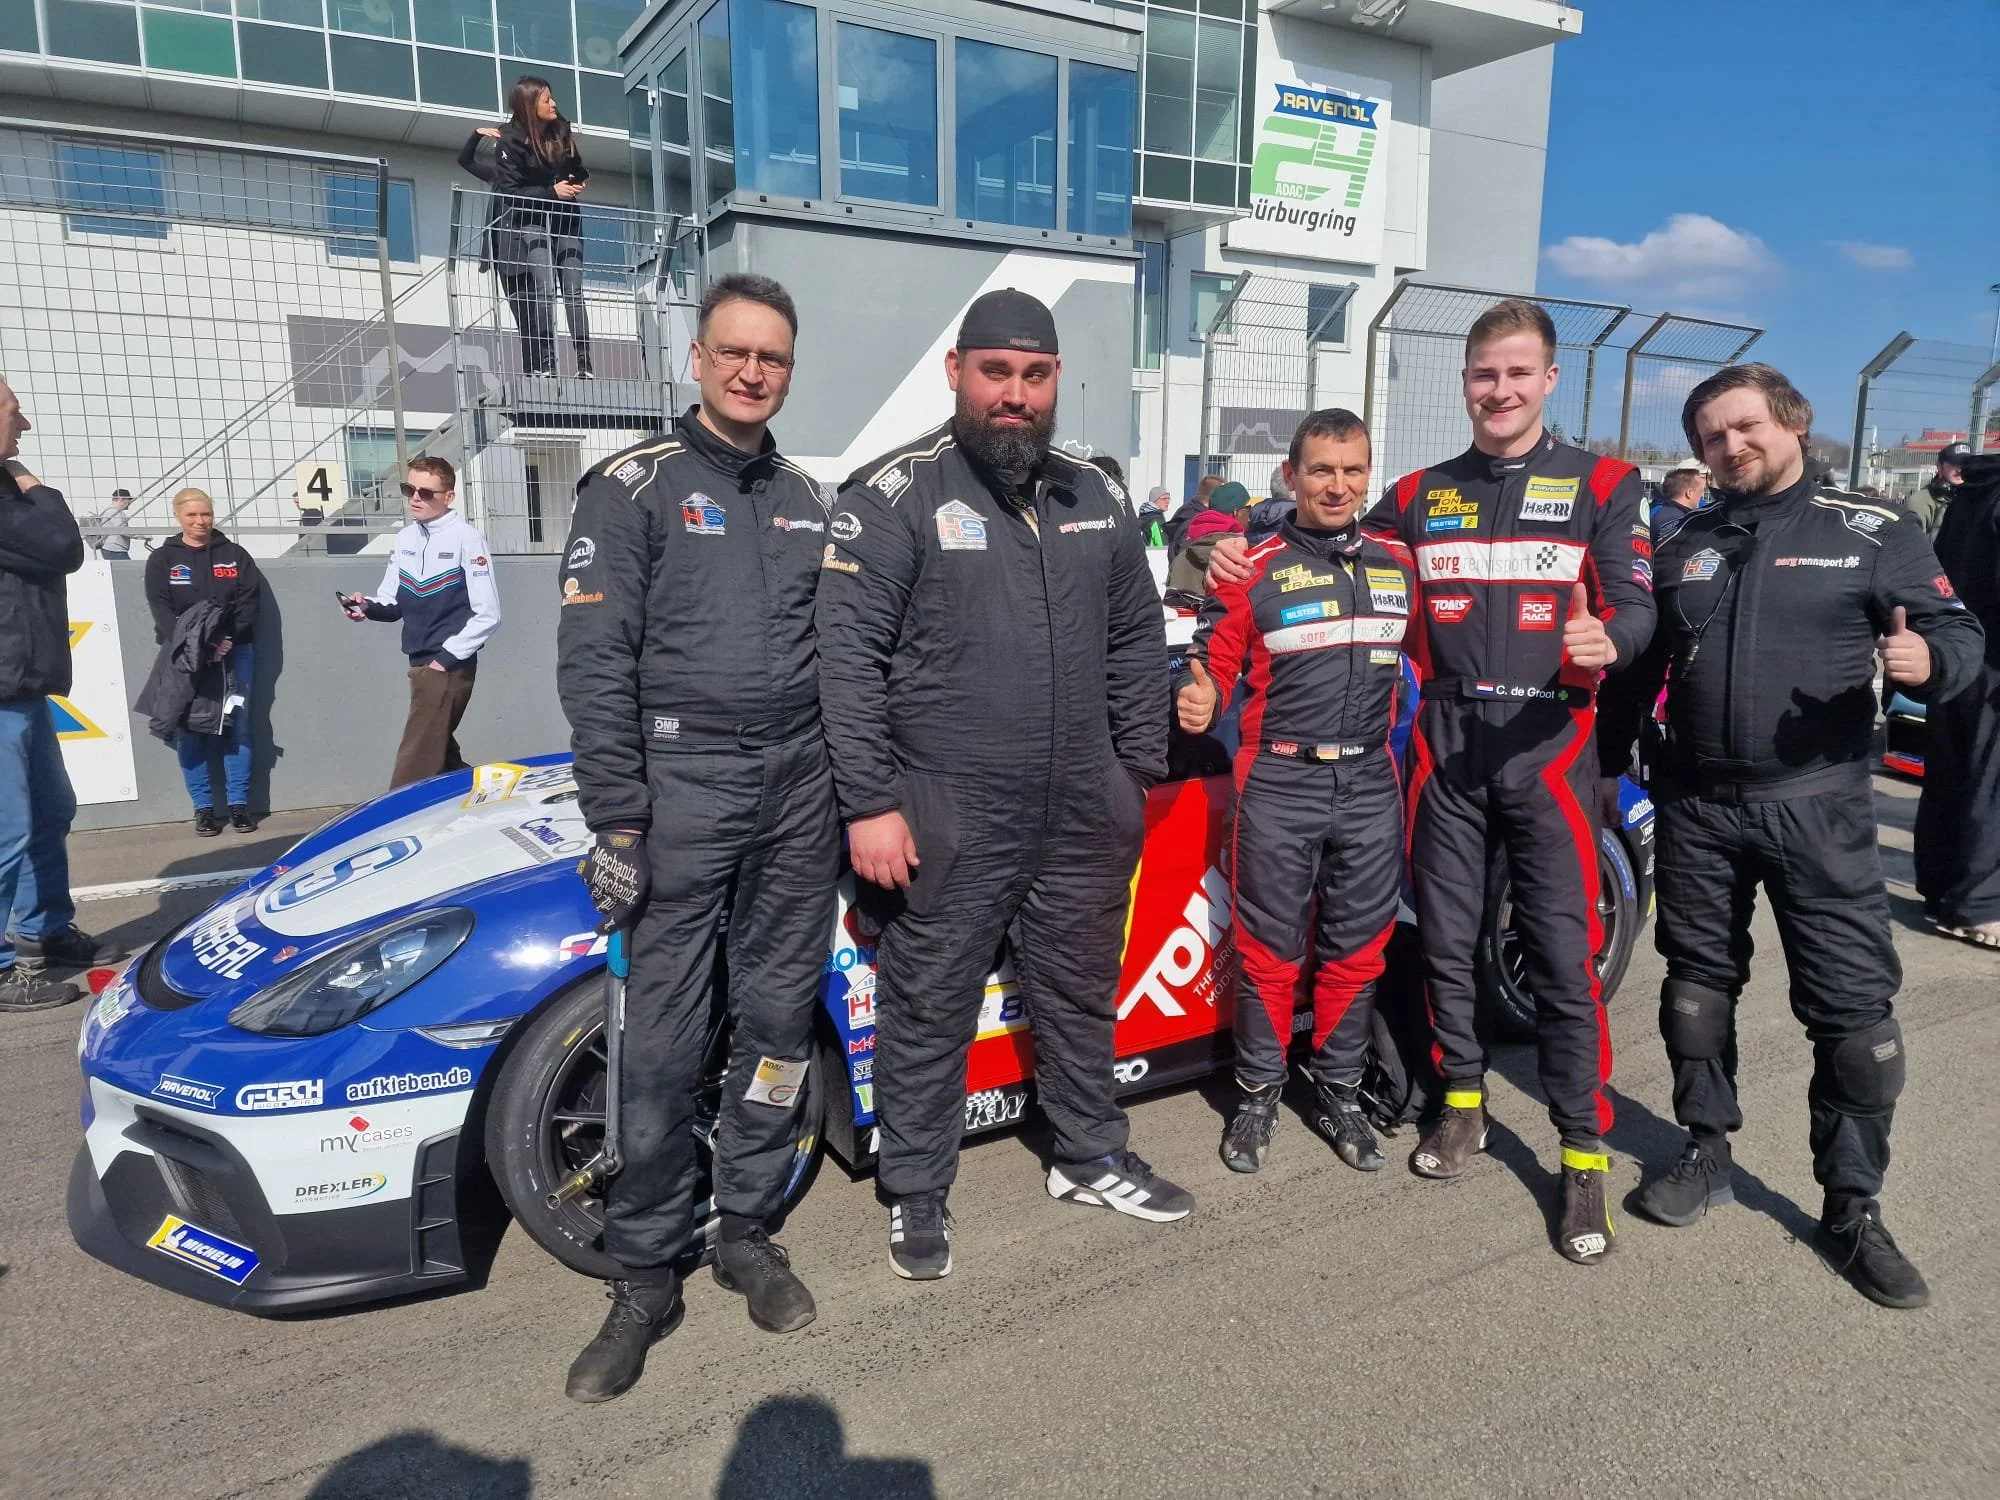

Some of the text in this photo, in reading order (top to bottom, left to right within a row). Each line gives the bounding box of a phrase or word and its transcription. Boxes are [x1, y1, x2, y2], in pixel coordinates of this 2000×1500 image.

[1283, 92, 1370, 123] RAVENOL
[1275, 182, 1304, 199] ADAC
[307, 467, 332, 501] 4
[879, 469, 902, 491] OMP
[1430, 490, 1456, 499] GET
[1441, 498, 1460, 506] ON
[683, 506, 726, 526] HS
[1431, 503, 1476, 515] TRACK
[939, 516, 986, 540] HS
[1853, 512, 1884, 527] OMP
[1274, 564, 1301, 579] GET
[1431, 556, 1460, 574] sorg
[1684, 559, 1720, 574] HS
[1283, 576, 1332, 591] TRACK
[1522, 603, 1553, 613] POP
[1522, 613, 1552, 621] RACE
[1300, 630, 1326, 644] sorg
[1496, 685, 1555, 699] C. de Groot
[654, 719, 680, 731] OMP
[1271, 743, 1298, 755] OMP
[591, 846, 638, 885] Mechanix
[591, 864, 639, 905] Mechanix
[1192, 969, 1216, 997] THE
[849, 993, 877, 1018] H
[999, 996, 1025, 1023] 8
[1113, 1057, 1149, 1084] RO
[160, 1080, 214, 1102] RAVENOL
[347, 1067, 472, 1101] aufkleben.de
[295, 1177, 374, 1197] DREXLER
[1573, 1236, 1607, 1253] OMP
[180, 1238, 246, 1270] MICHELIN
